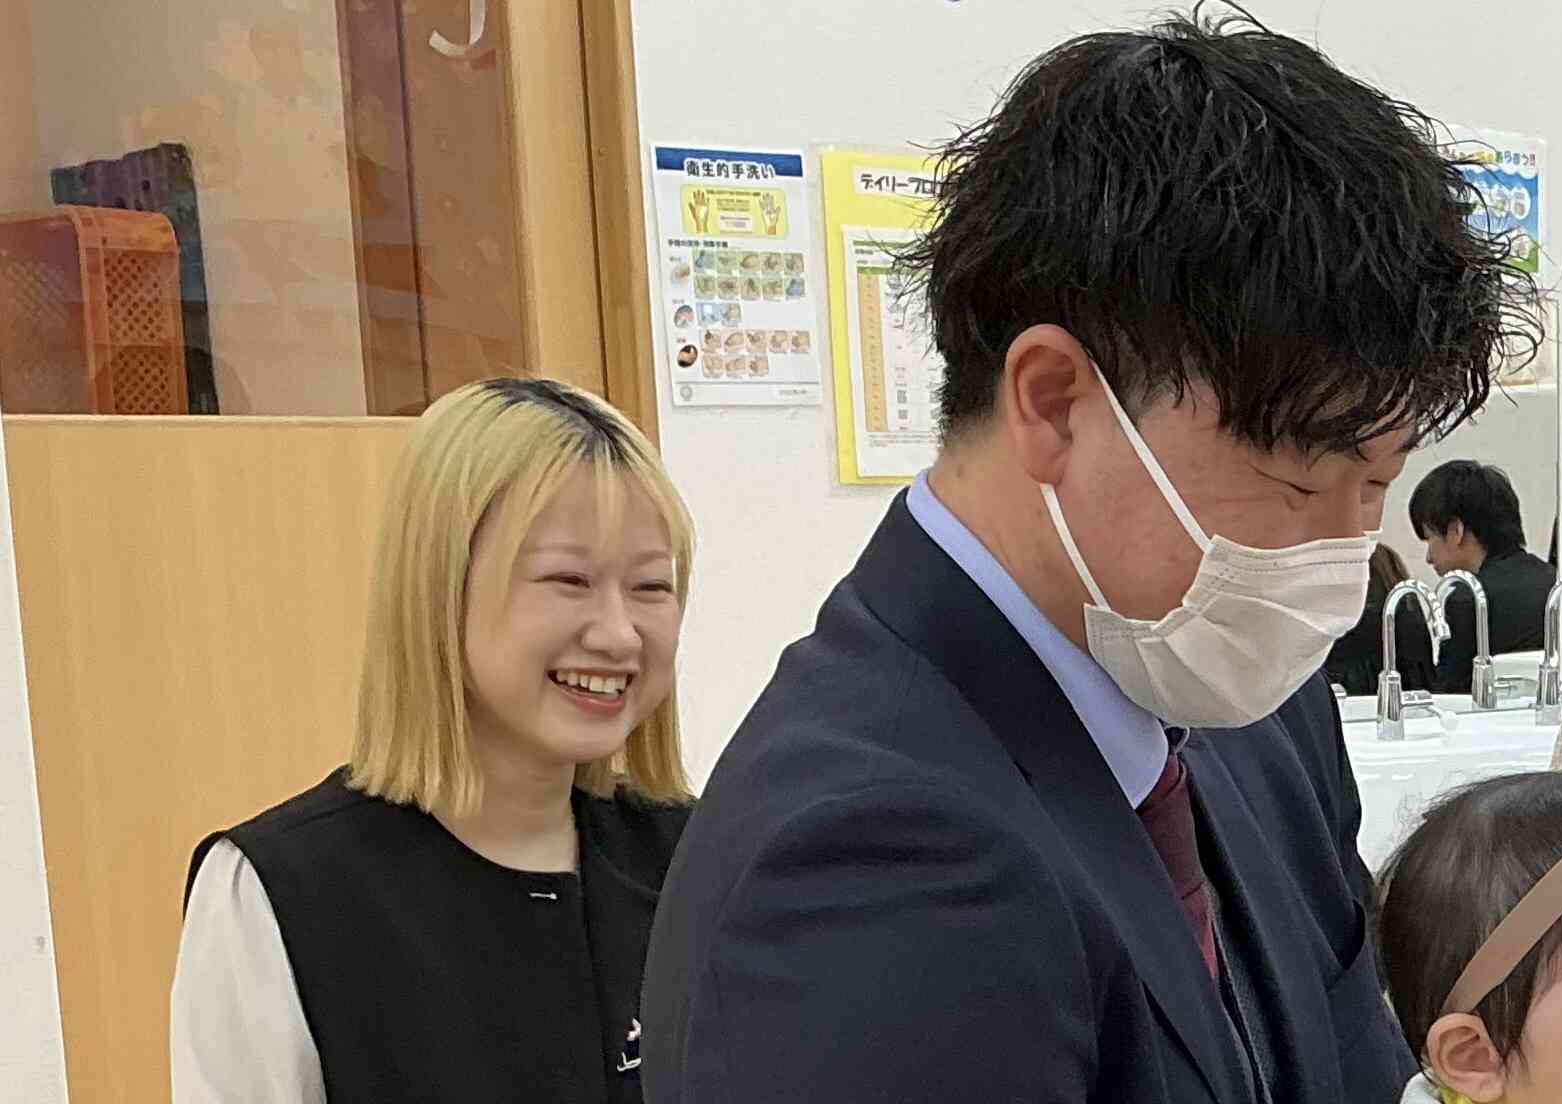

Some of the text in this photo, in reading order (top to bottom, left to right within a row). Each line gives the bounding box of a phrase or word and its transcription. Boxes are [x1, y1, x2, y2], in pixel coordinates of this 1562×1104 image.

[686, 159, 775, 180] 衛生的手洗い
